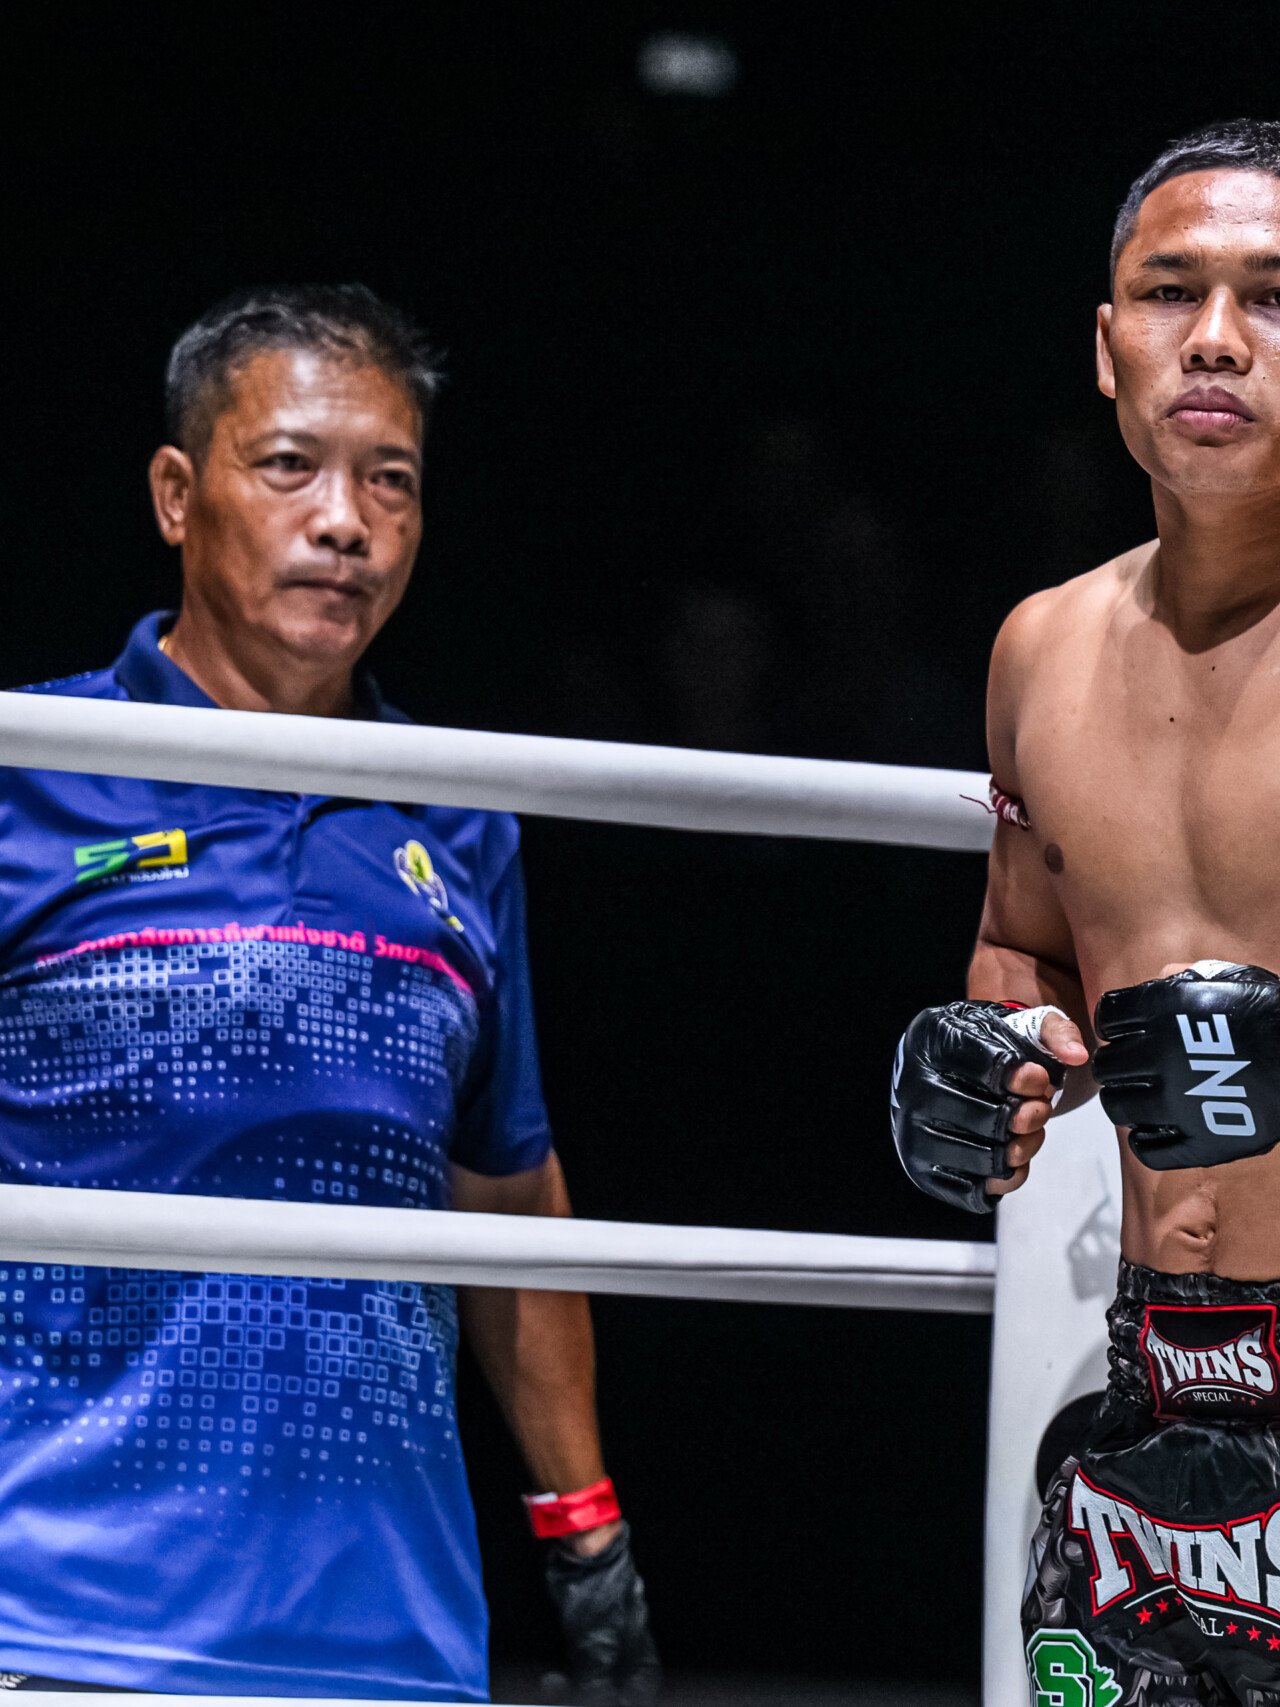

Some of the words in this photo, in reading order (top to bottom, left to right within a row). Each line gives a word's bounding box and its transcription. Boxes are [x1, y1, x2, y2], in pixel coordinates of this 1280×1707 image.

[1176, 1013, 1257, 1137] ONE
[1147, 1326, 1274, 1393] TWINS
[1192, 1391, 1232, 1402] SPECIAL
